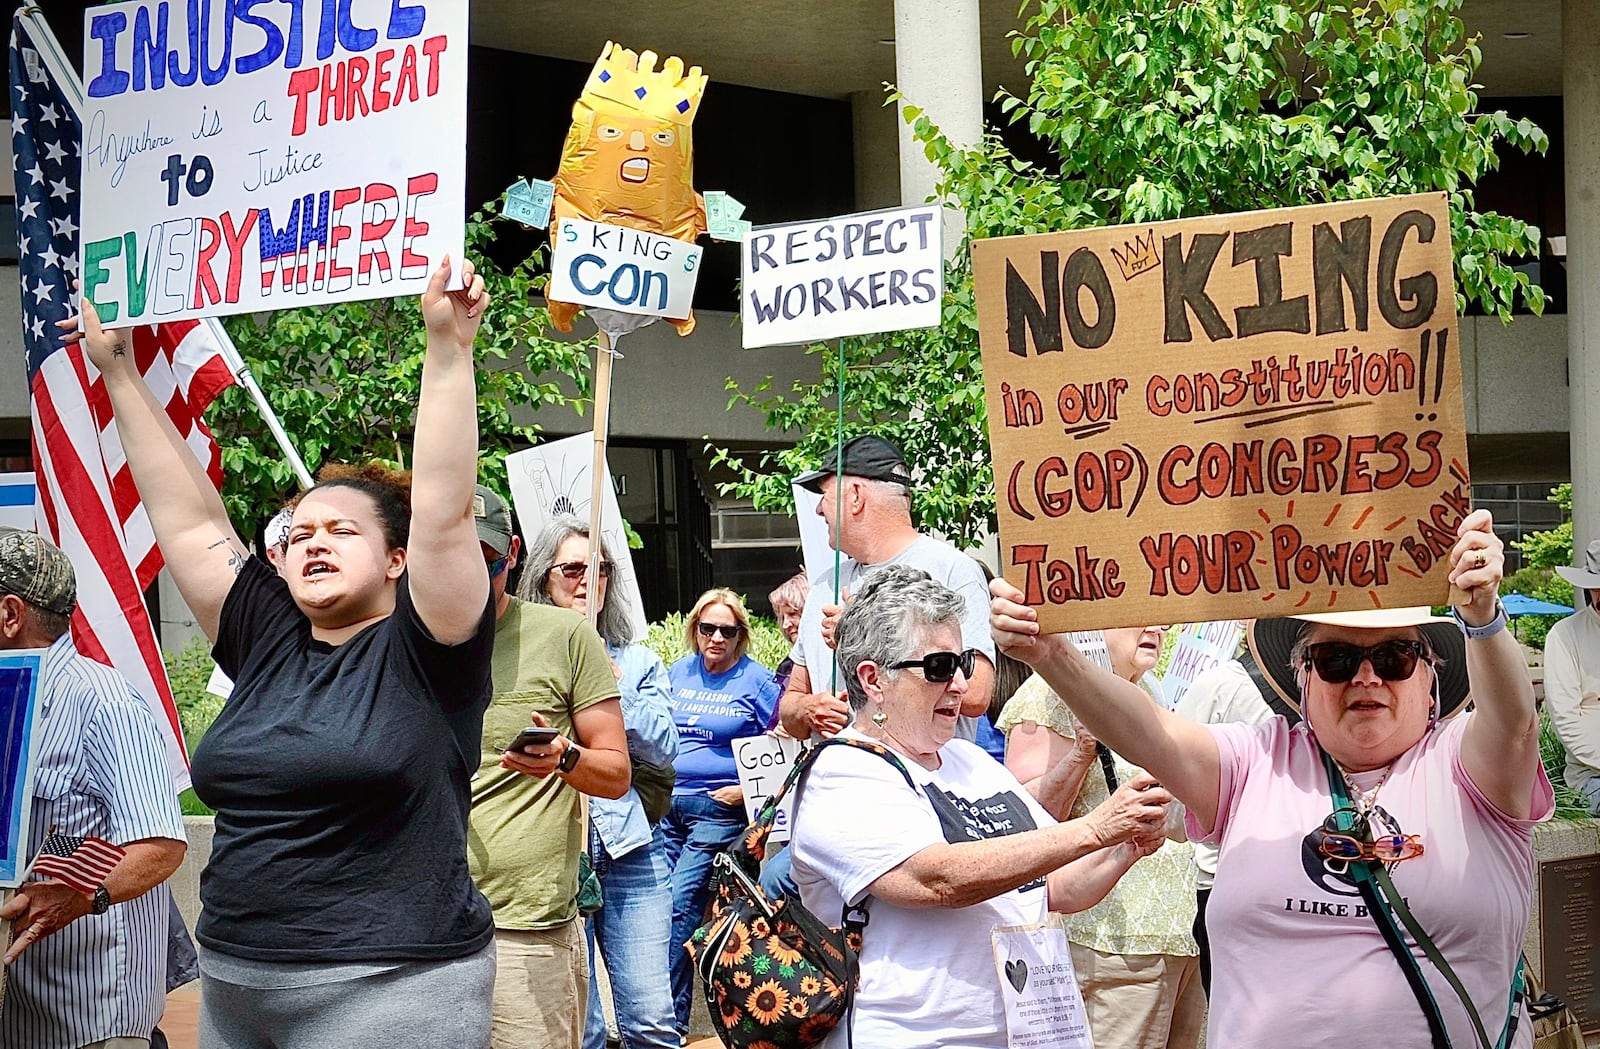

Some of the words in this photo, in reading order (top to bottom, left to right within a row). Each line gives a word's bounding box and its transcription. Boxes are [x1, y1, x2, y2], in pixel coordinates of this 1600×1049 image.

[87, 110, 174, 188] Anywhere
[191, 105, 222, 140] is
[253, 99, 272, 123] a
[287, 34, 447, 136] THREAT
[161, 154, 214, 206] to
[243, 145, 323, 192] Justice
[84, 172, 438, 323] EVERYWHERE
[750, 213, 934, 273] RESPECT
[750, 268, 937, 325] WORKERS
[1005, 246, 1116, 357] NO
[1163, 209, 1438, 344] KING
[1001, 382, 1043, 428] in
[1059, 377, 1128, 426] our
[1007, 442, 1149, 521] (GOP)
[1157, 430, 1443, 505] CONGRESS
[1011, 543, 1126, 606] Take
[1139, 529, 1261, 597] YOUR
[1271, 523, 1394, 590] Power
[681, 702, 742, 717] LANDSCAPING
[696, 690, 734, 704] SEASONS
[739, 736, 786, 770] God
[748, 776, 768, 799] I
[1285, 898, 1293, 911] I
[1299, 899, 1349, 917] LIKE
